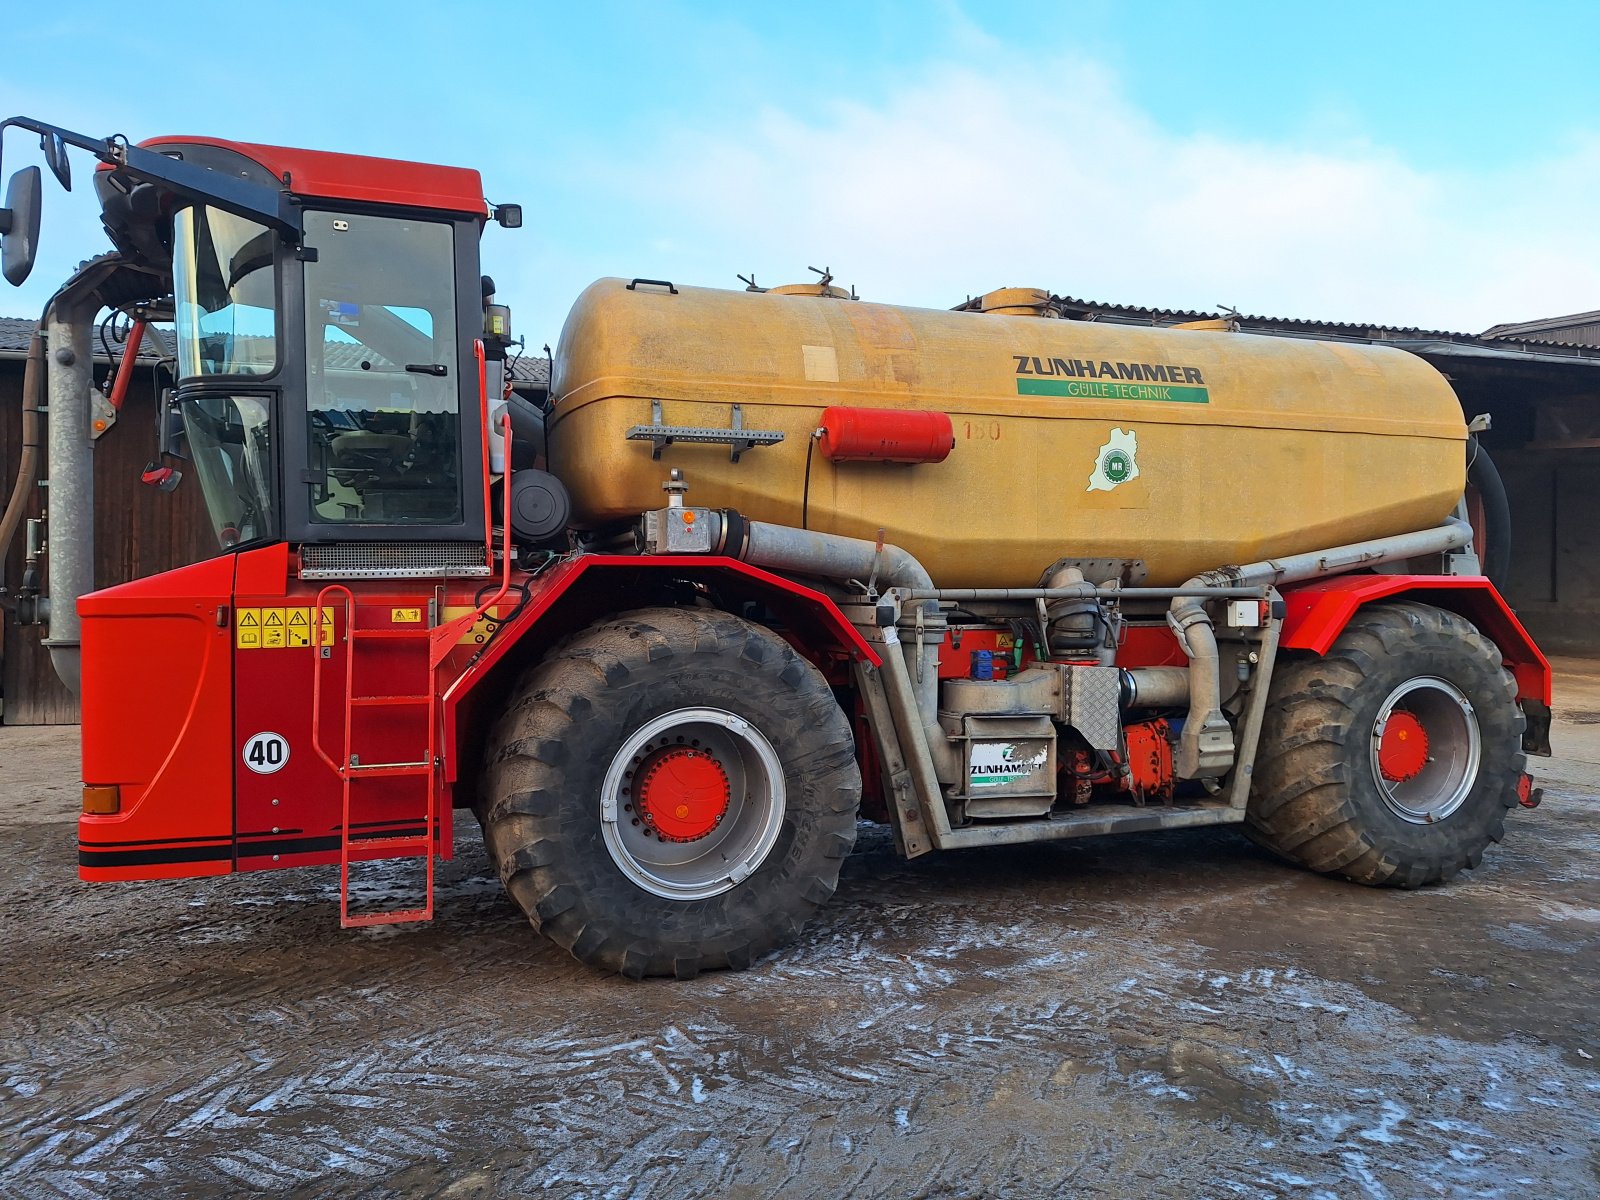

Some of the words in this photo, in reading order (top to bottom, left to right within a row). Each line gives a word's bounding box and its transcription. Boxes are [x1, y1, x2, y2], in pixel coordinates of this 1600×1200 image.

[1012, 355, 1205, 385] ZUNHAMMER
[1067, 382, 1172, 400] GÜLLE-TECHNIK
[1111, 462, 1123, 471] MR
[249, 739, 283, 766] 40
